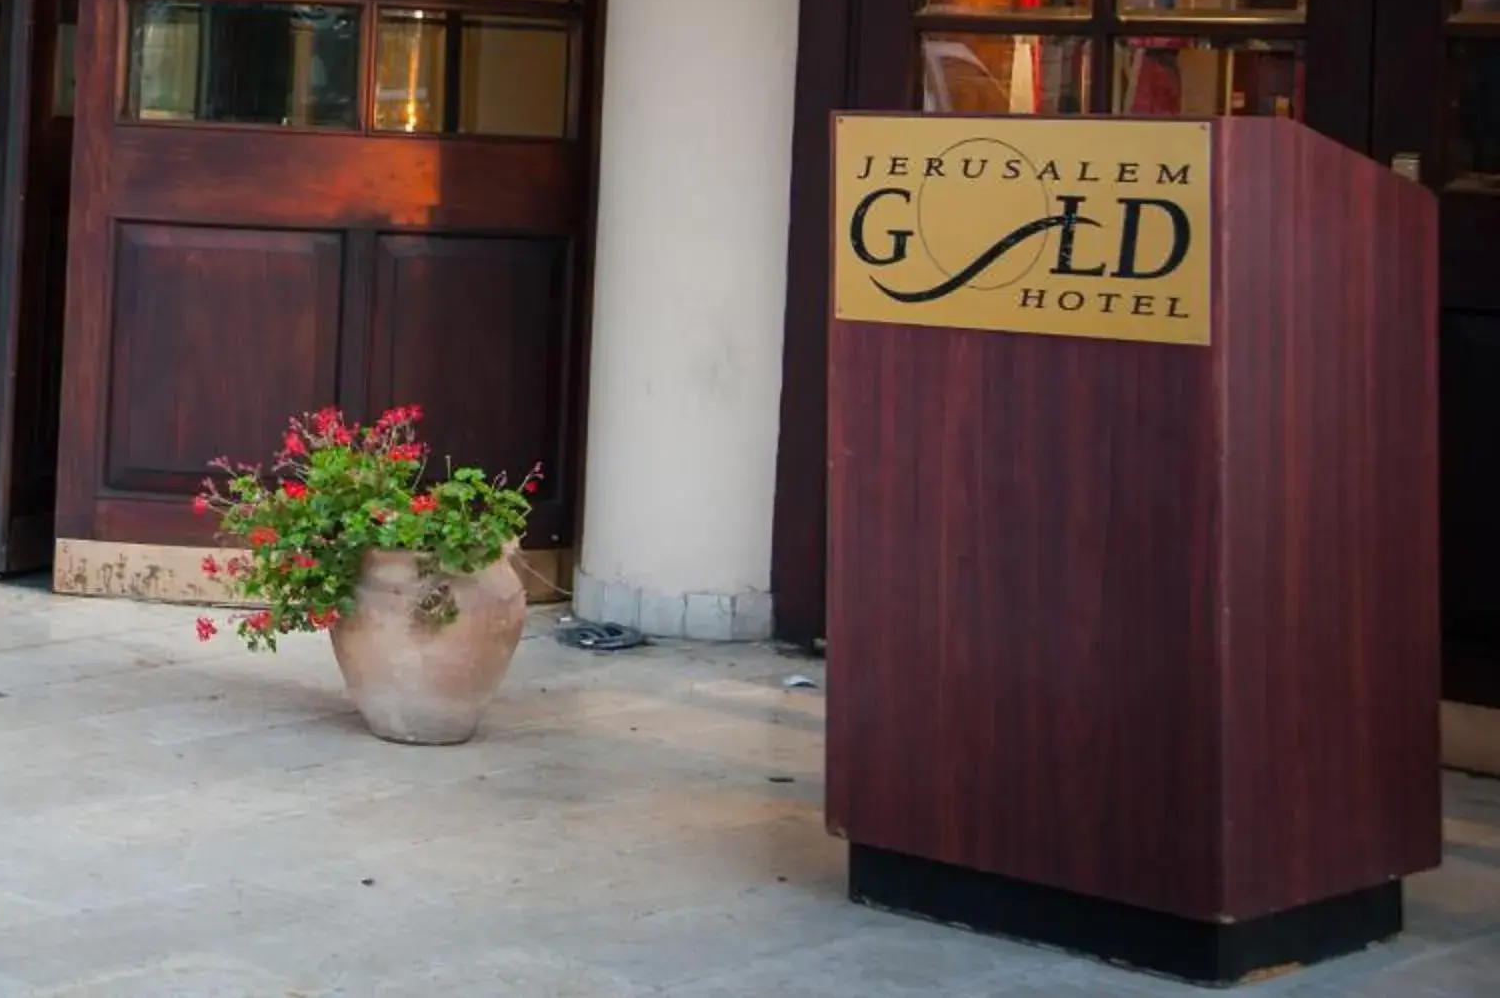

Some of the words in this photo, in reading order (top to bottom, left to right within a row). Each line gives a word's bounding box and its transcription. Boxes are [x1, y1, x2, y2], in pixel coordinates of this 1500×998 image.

[857, 155, 1192, 185] JERUSALEM
[850, 186, 1192, 303] GOLD
[1019, 288, 1190, 319] HOTEL
